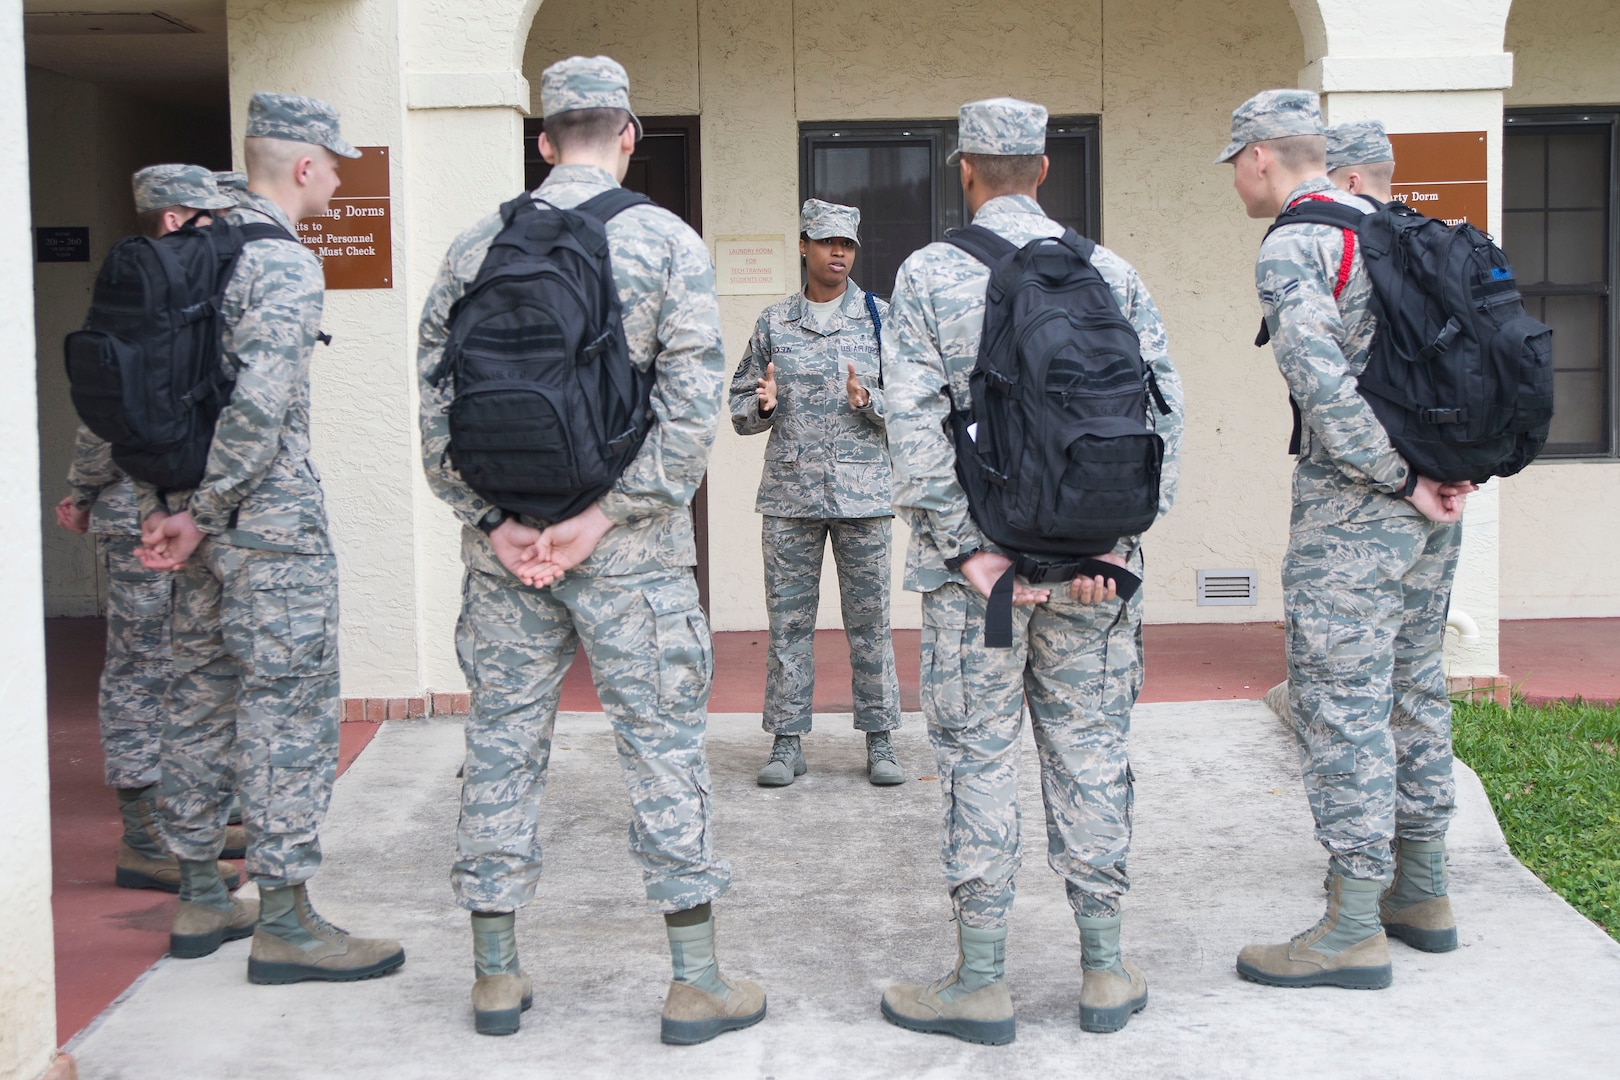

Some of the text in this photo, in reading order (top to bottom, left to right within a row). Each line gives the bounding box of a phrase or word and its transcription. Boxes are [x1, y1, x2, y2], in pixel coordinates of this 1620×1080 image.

[1411, 191, 1439, 202] Dorm
[345, 205, 385, 217] Dorms
[295, 222, 323, 231] its to
[298, 233, 374, 244] rized Personnel
[318, 246, 343, 257] Must
[345, 246, 376, 256] Check
